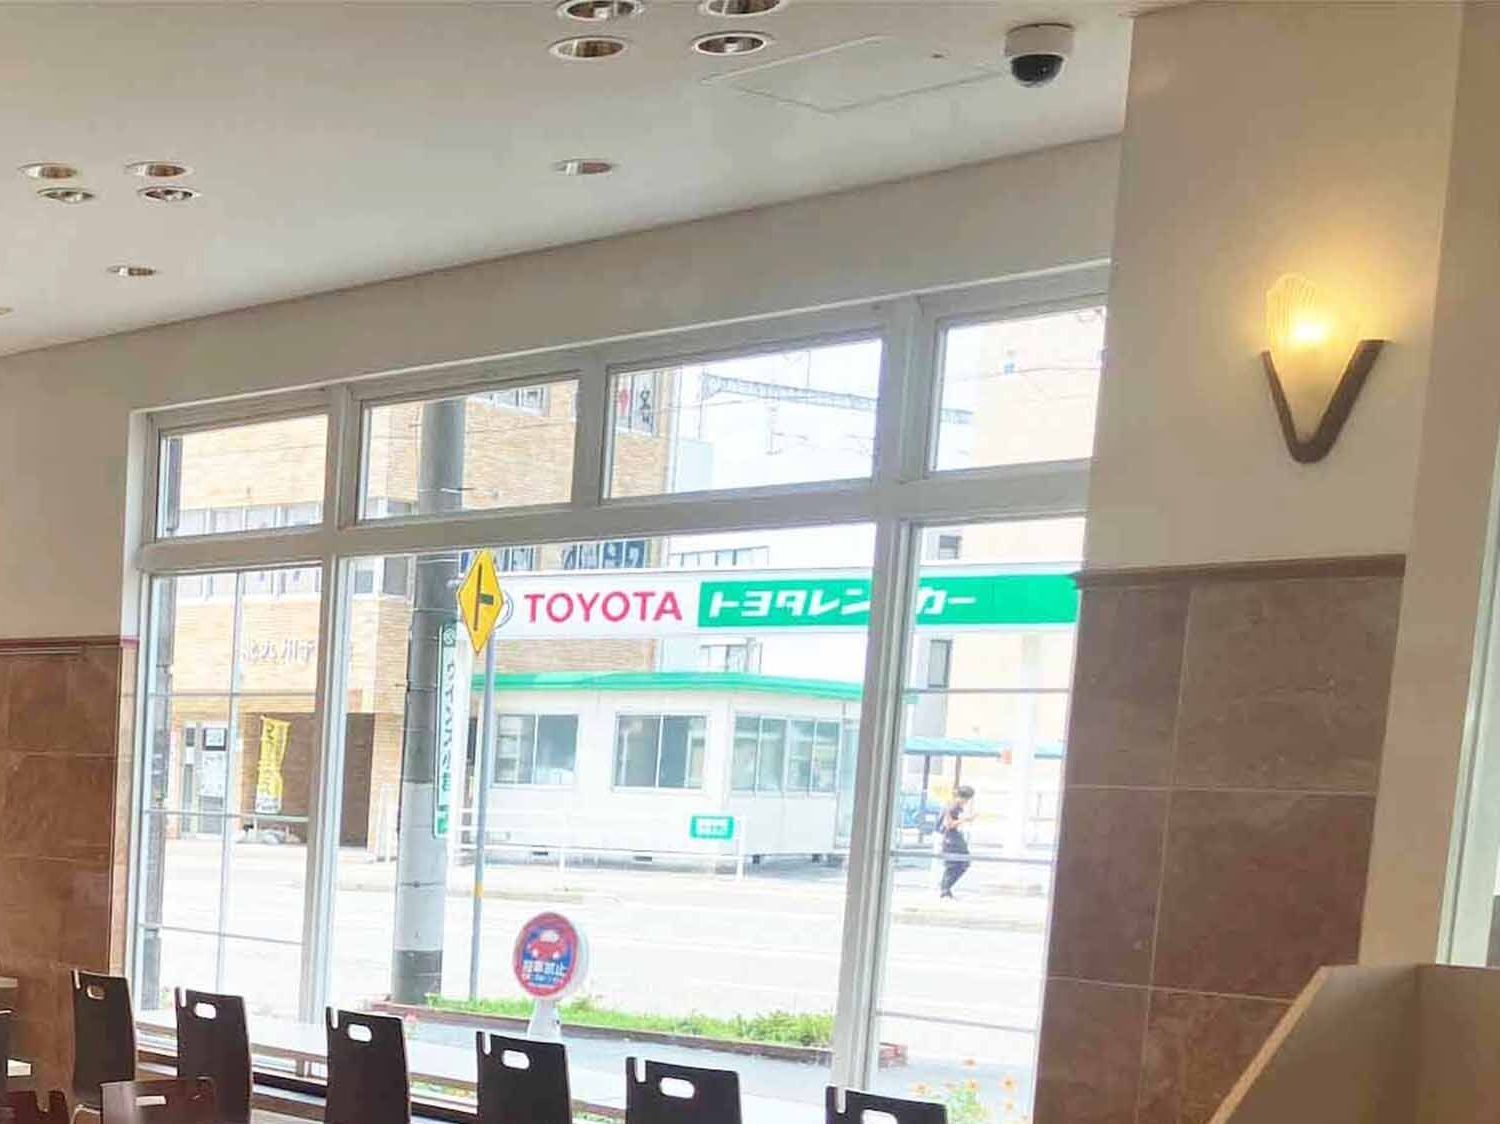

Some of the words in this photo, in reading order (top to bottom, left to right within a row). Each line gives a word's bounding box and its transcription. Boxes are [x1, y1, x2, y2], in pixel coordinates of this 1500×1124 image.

[524, 591, 683, 623] TOYOTA
[708, 587, 977, 618] トヨタレンカー
